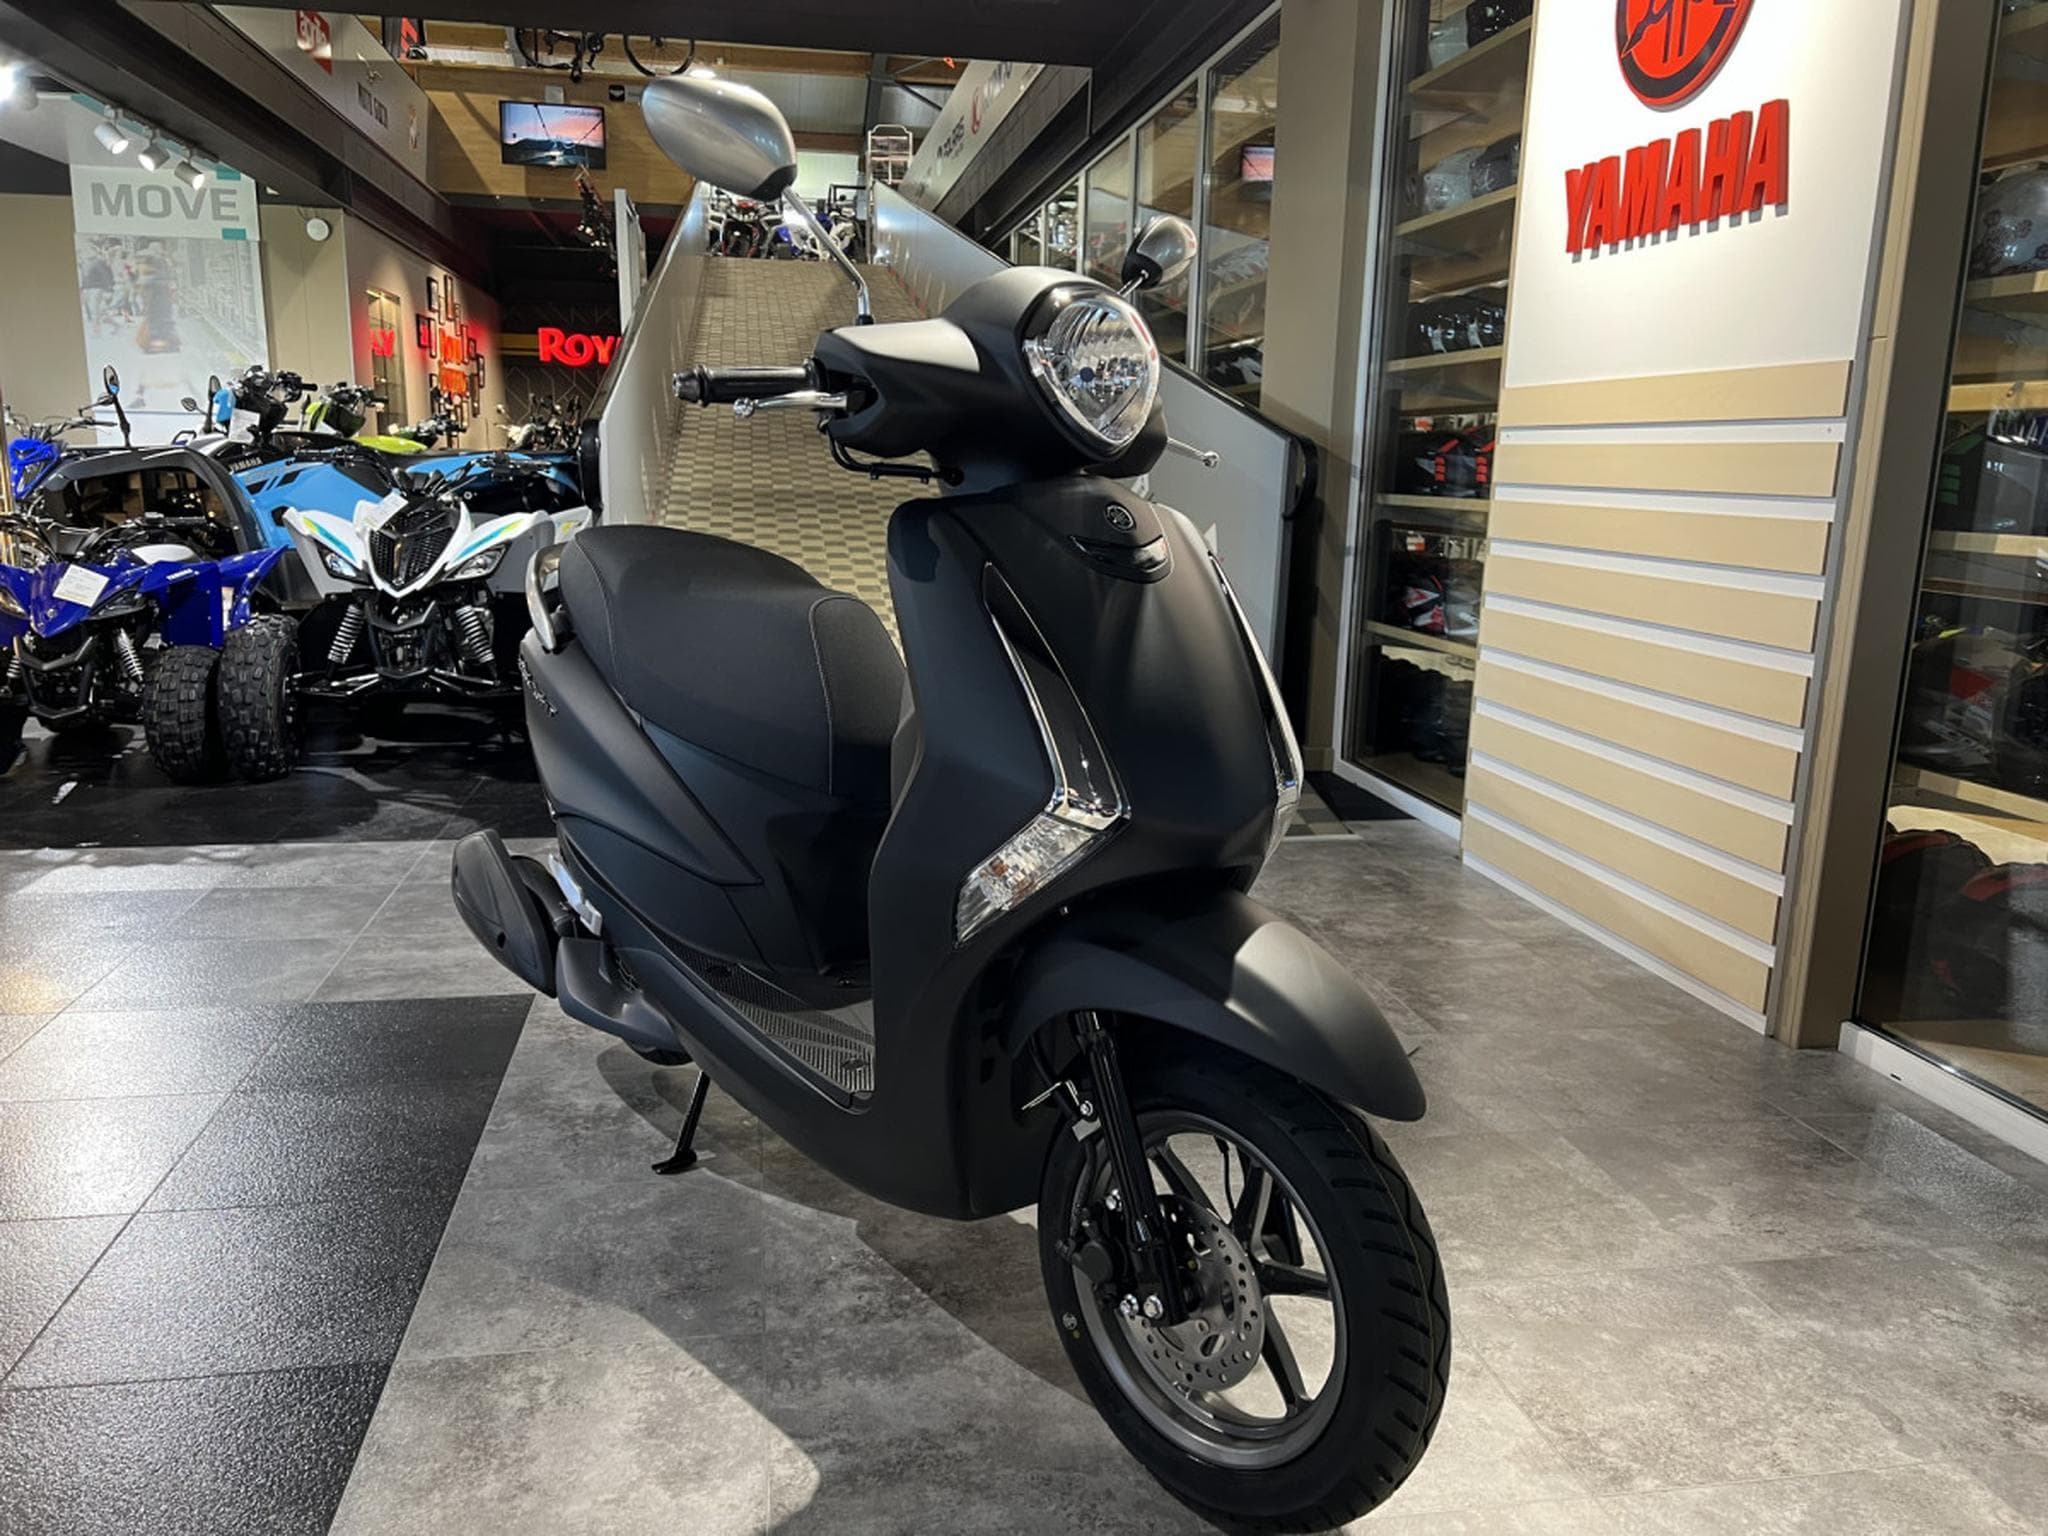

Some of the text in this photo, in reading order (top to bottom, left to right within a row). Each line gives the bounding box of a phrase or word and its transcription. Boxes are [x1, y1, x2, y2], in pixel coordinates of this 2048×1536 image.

[1565, 98, 1789, 254] YAMAHA
[91, 182, 240, 222] MOVE
[538, 327, 623, 366] ROY
